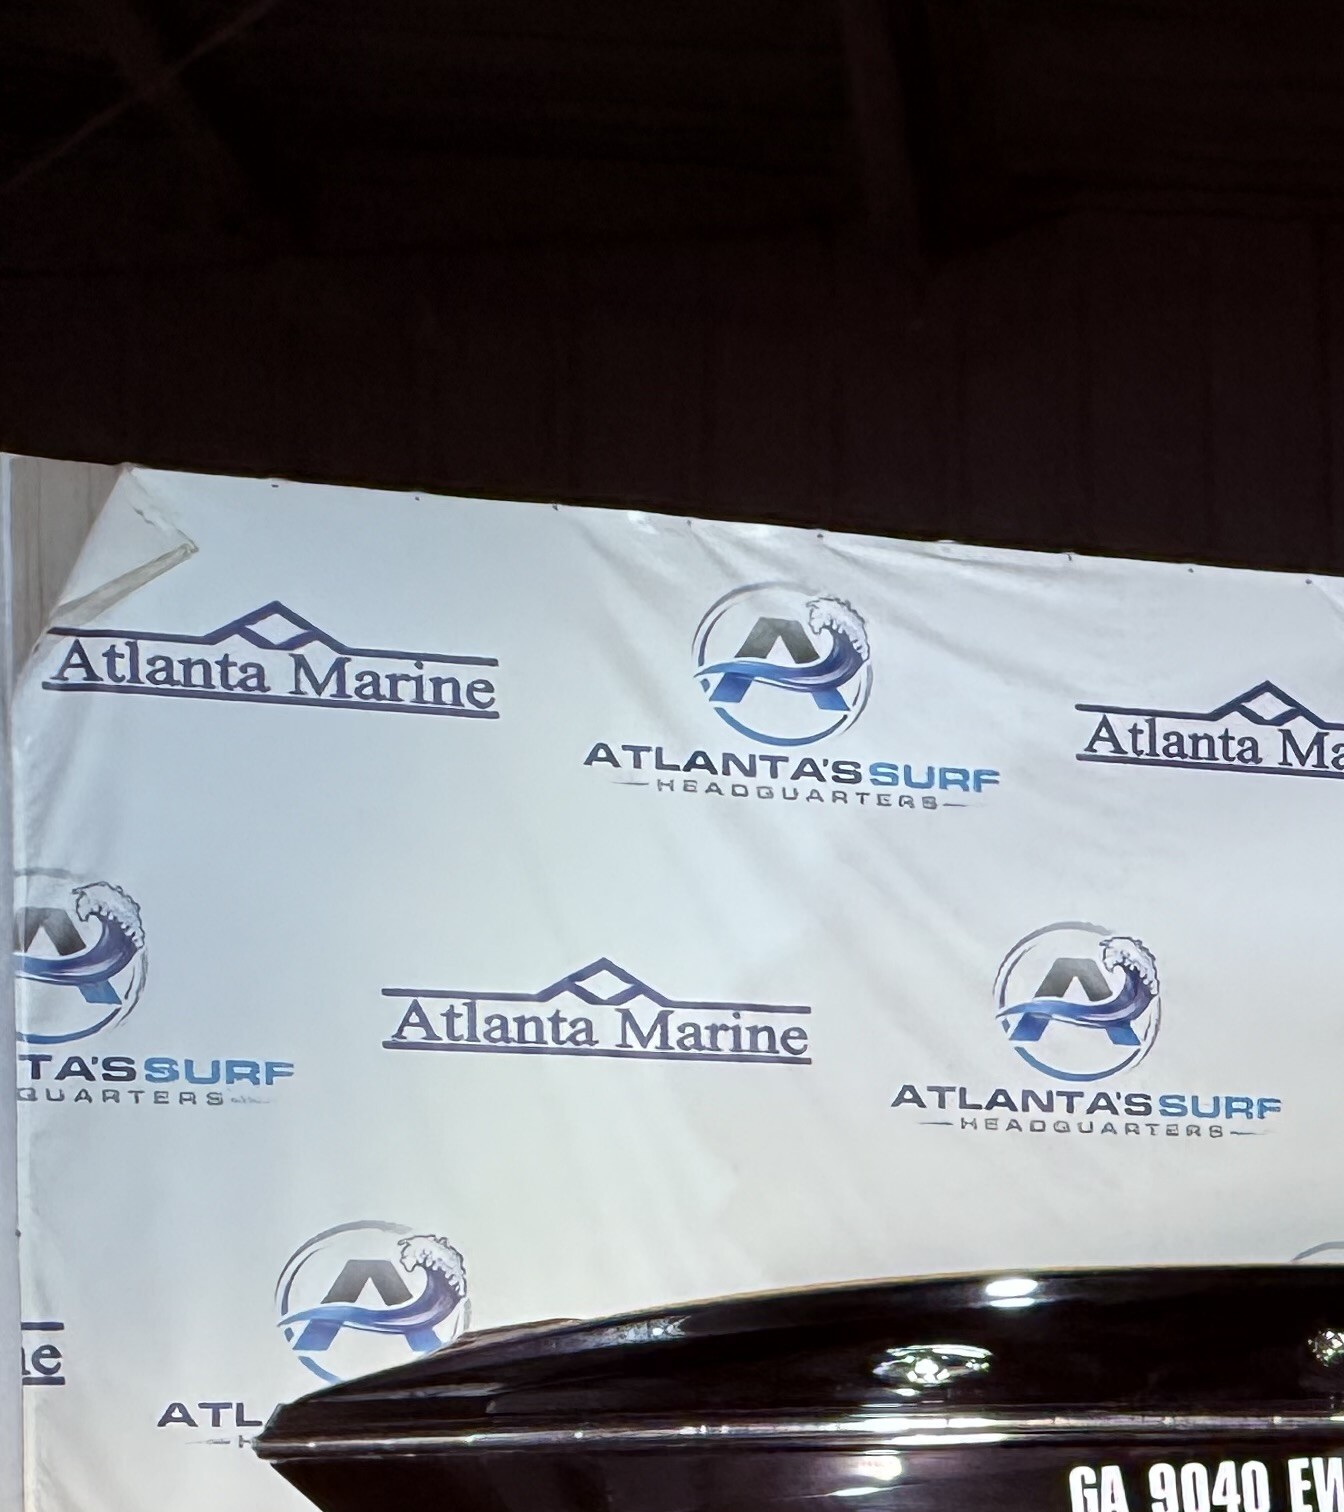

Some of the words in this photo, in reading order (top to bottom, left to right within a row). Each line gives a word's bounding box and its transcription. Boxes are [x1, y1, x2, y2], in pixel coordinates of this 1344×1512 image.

[51, 637, 271, 695] Atlanta
[290, 652, 497, 709] Marine
[1084, 715, 1262, 765] Atlanta
[656, 779, 938, 810] HEADQUARTERS
[392, 1000, 599, 1048] Atlanta
[615, 1006, 808, 1057] Marine
[17, 1087, 224, 1106] QUARTERS
[961, 1116, 1224, 1138] HEADQUARTERS
